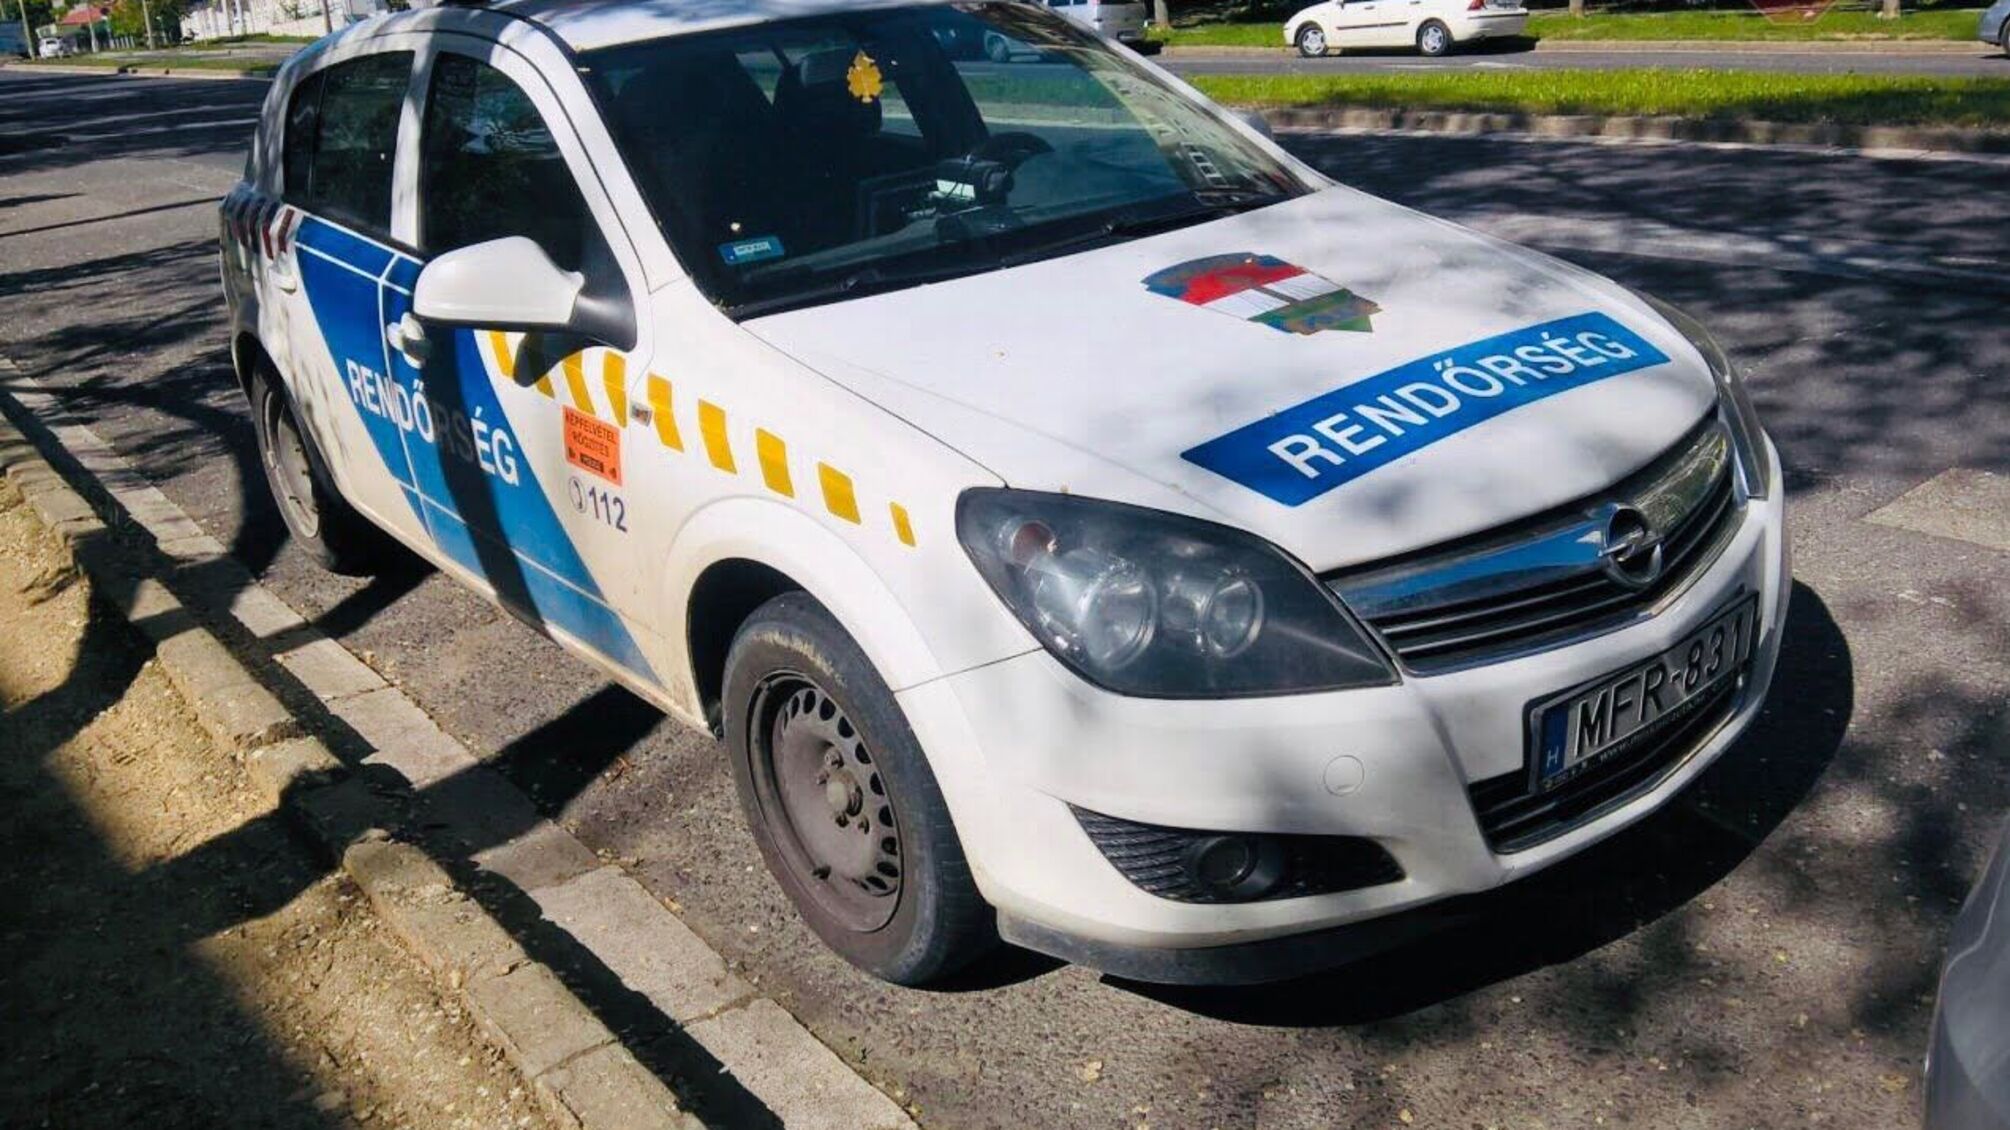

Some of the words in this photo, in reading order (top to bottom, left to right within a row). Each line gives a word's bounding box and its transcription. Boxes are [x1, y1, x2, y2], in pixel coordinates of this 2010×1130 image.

[346, 359, 518, 486] RENDŐRSÉG
[1266, 331, 1638, 479] RENDŐRSÉG
[588, 486, 627, 533] 112
[1574, 612, 1742, 757] MFR-831
[1546, 745, 1559, 768] H
